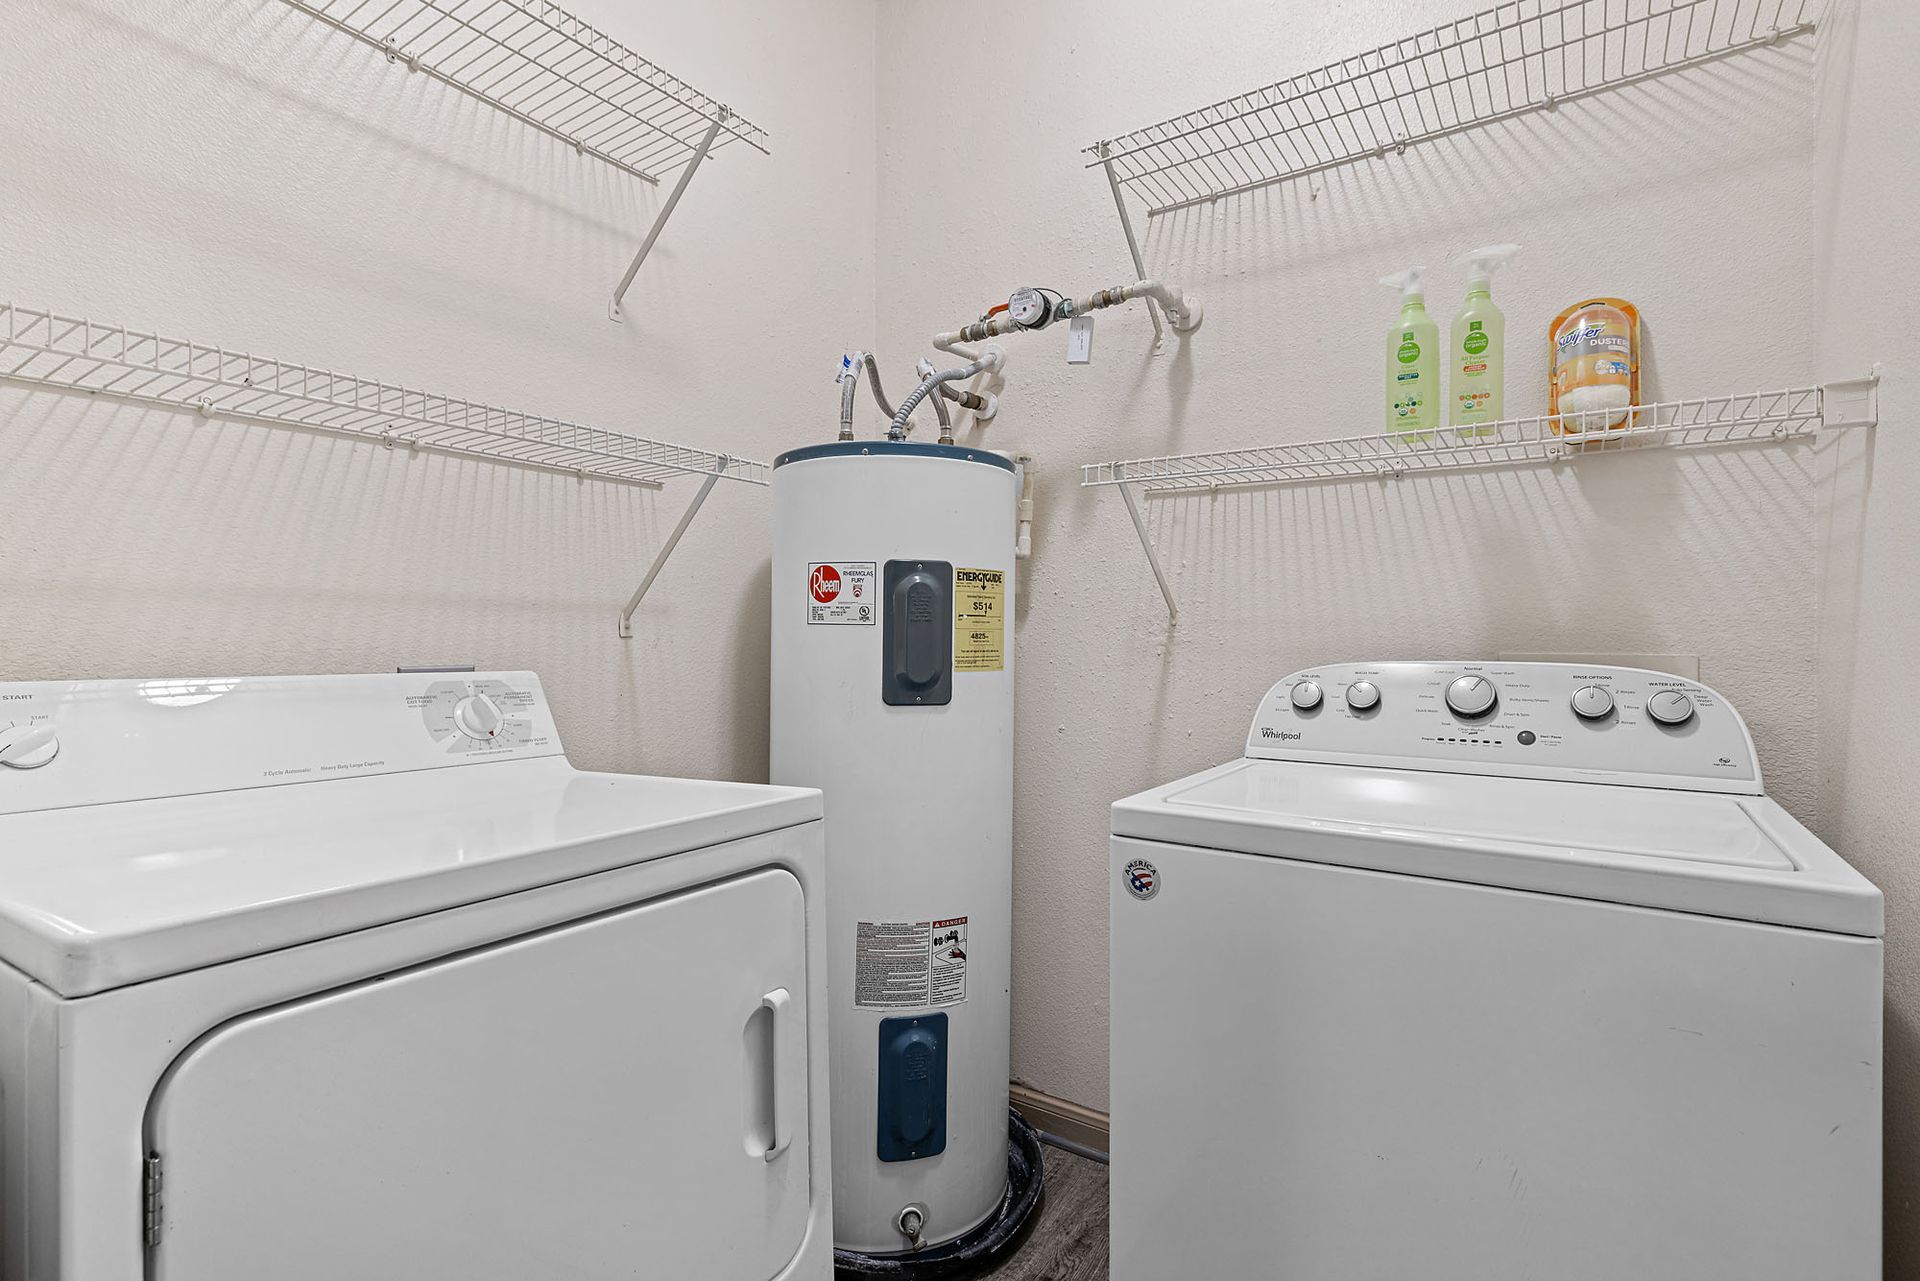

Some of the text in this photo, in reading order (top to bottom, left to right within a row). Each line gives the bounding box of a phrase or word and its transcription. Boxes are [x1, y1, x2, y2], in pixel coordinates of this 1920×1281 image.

[1559, 326, 1602, 348] Swiffer
[814, 566, 840, 599] Rheem
[972, 601, 993, 611] $514
[1261, 730, 1302, 741] Whirlpool
[1125, 860, 1157, 876] AMERICA
[941, 918, 966, 927] DANGER
